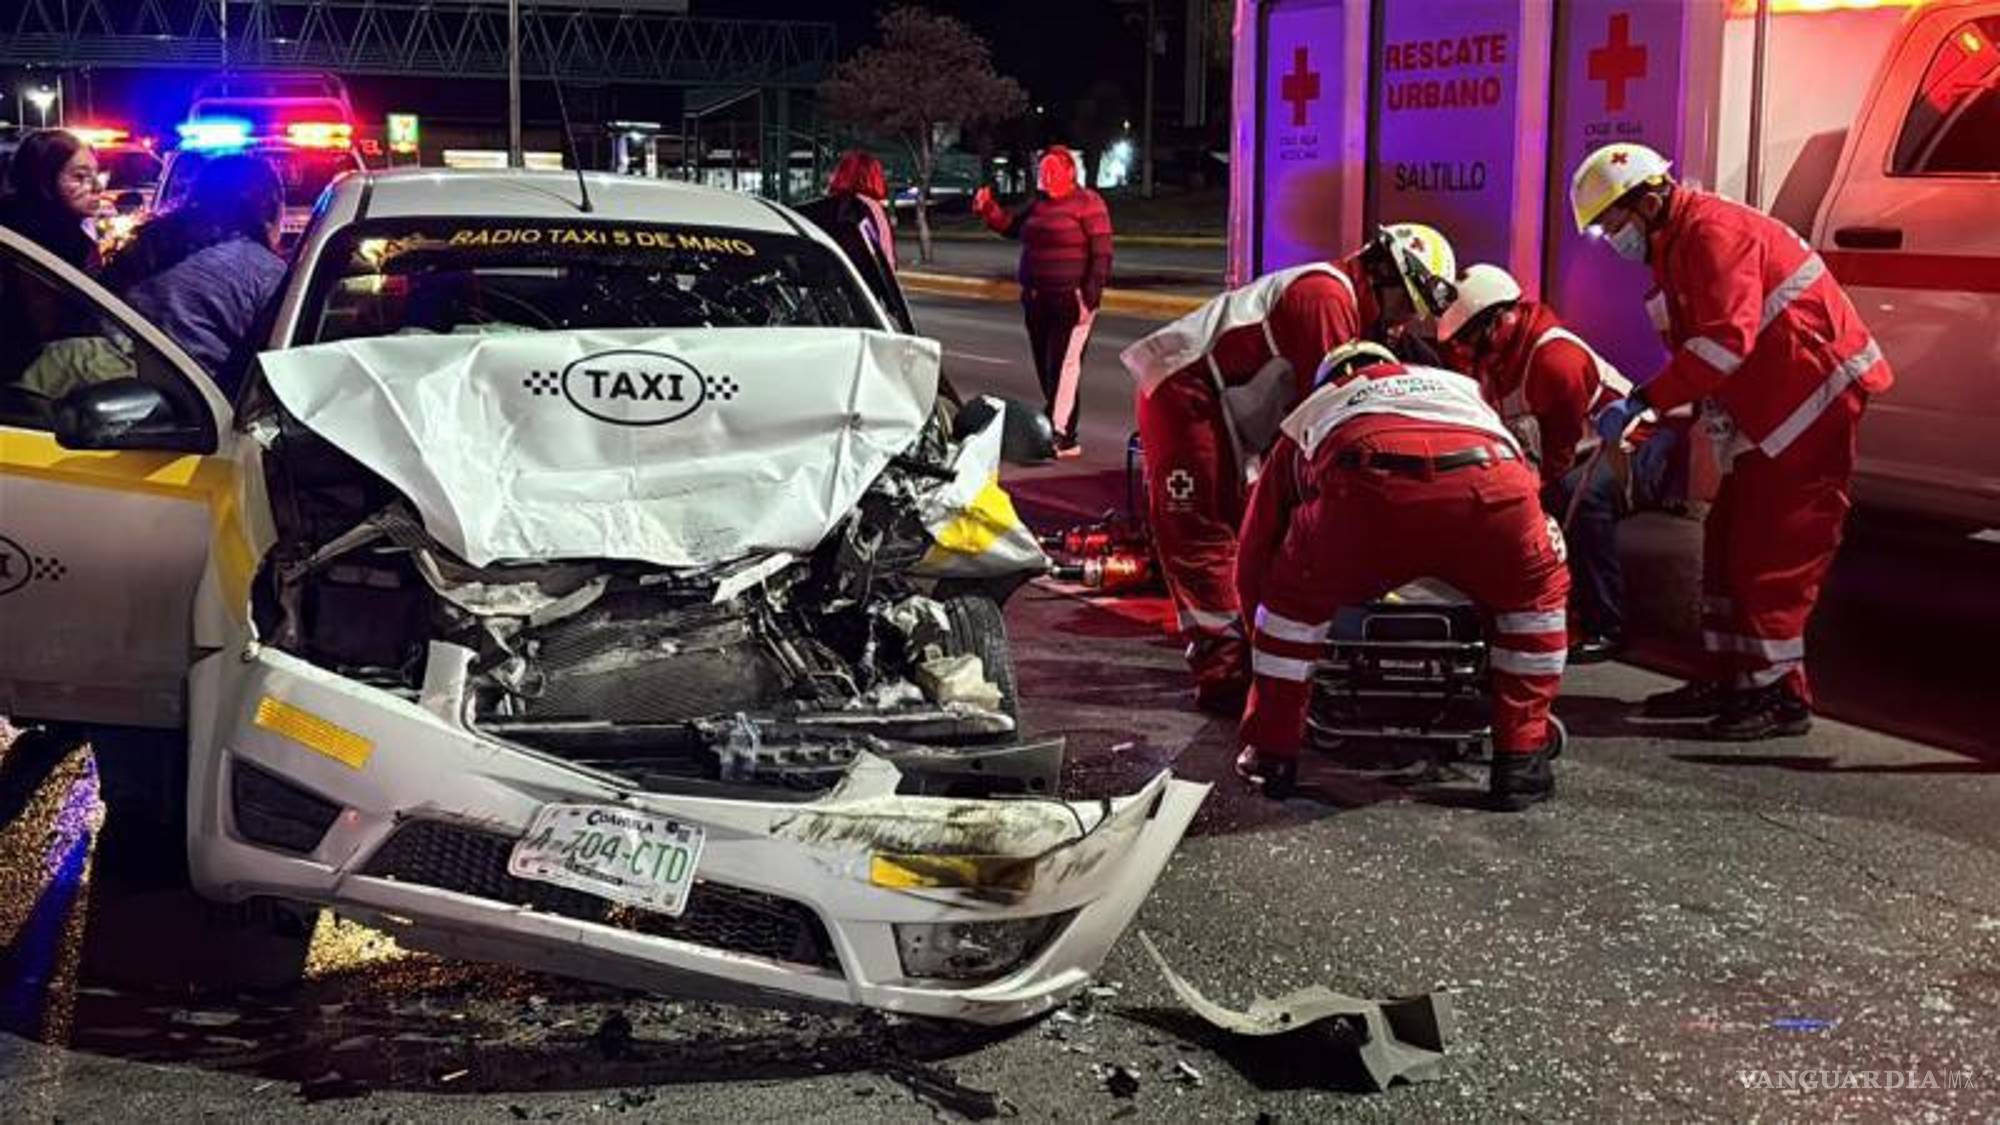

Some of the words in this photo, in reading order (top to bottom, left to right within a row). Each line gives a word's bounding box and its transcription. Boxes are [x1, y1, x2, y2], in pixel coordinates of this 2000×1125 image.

[1385, 34, 1506, 71] RESCATE
[1387, 77, 1501, 111] URBANO
[1395, 160, 1486, 192] SALTILLO
[450, 229, 541, 245] RADIO
[547, 229, 607, 244] TAXI
[613, 231, 630, 245] 5
[636, 232, 675, 248] DE
[677, 234, 756, 256] MAYO
[585, 369, 684, 401] TAXI
